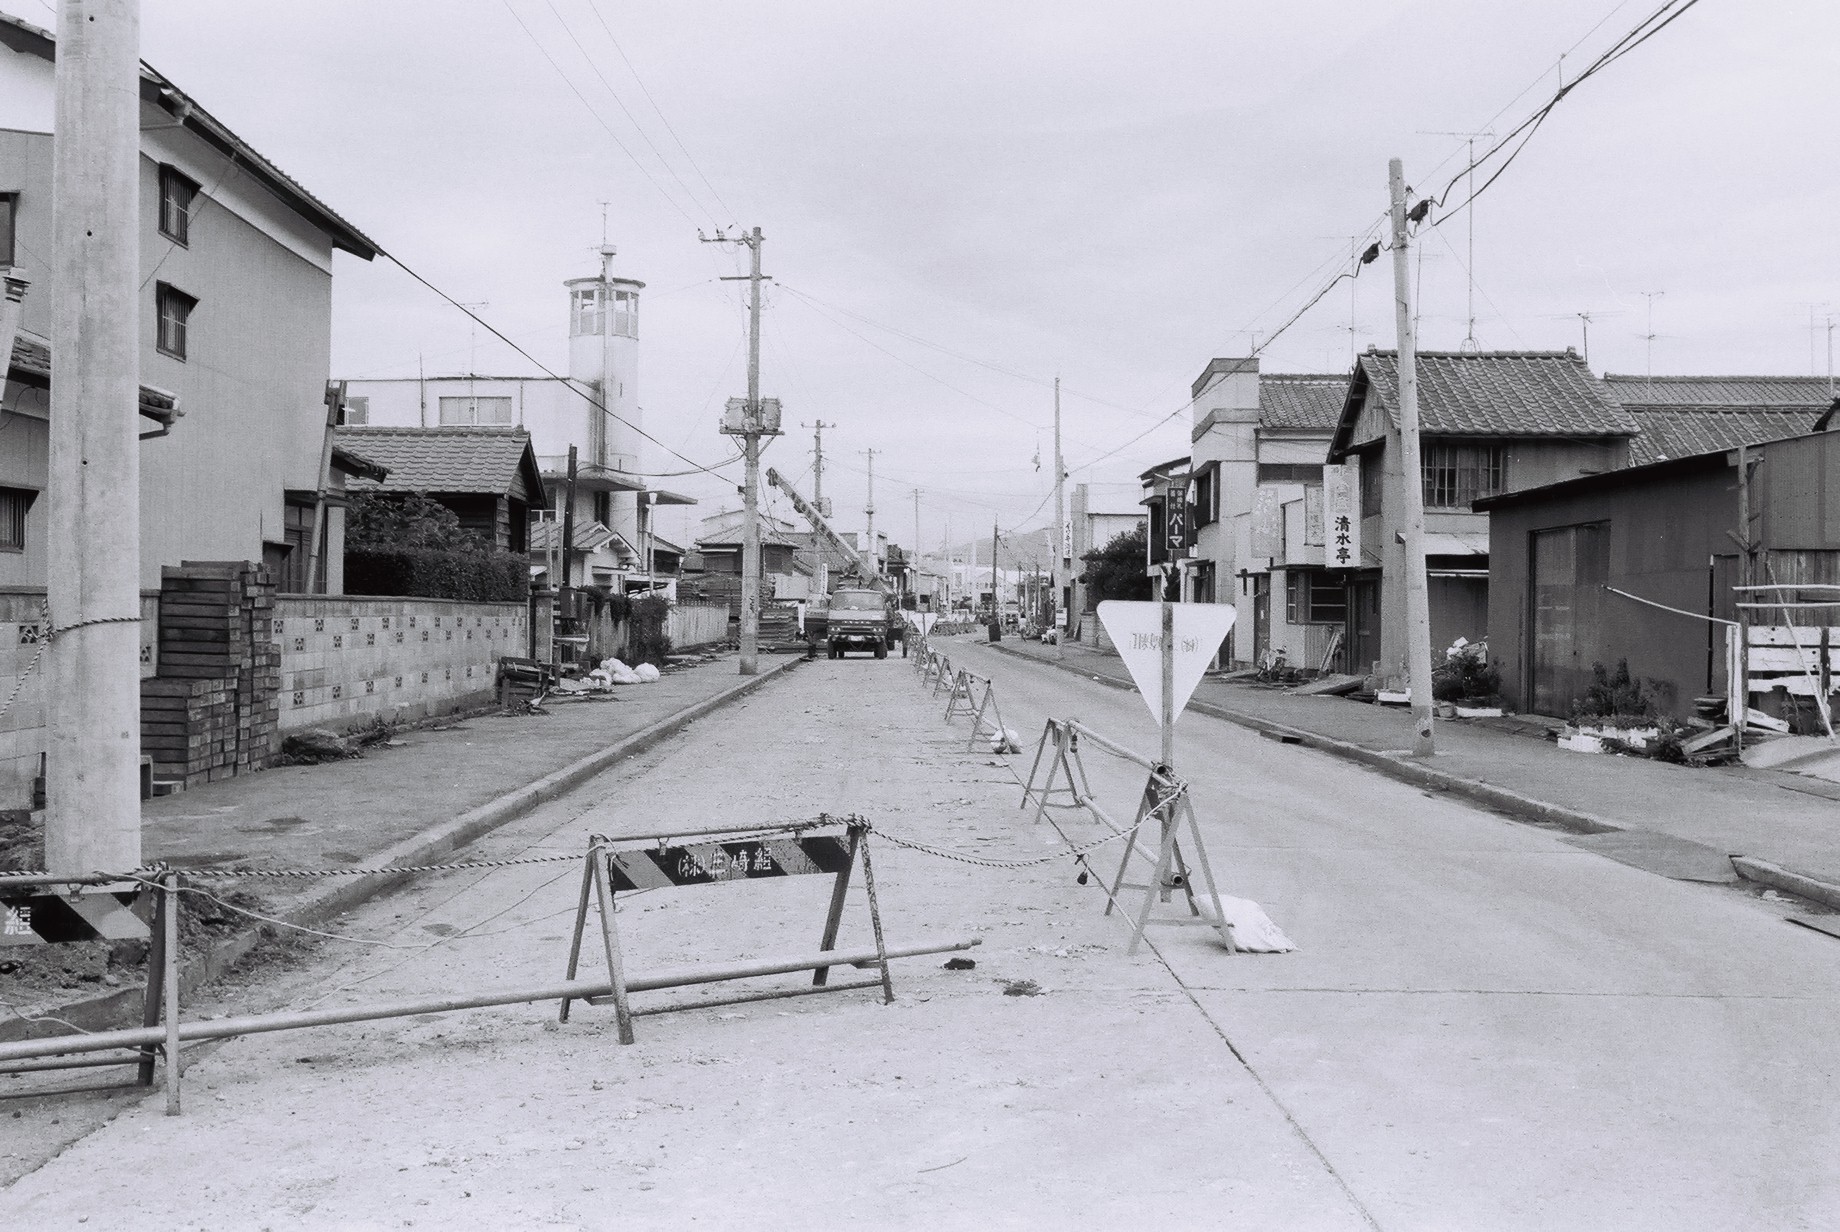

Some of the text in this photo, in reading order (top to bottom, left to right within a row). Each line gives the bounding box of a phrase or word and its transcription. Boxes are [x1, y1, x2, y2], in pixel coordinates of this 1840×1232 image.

[1169, 513, 1184, 548] パーマ
[1334, 515, 1351, 565] 清水亭
[4, 906, 33, 936] 組
